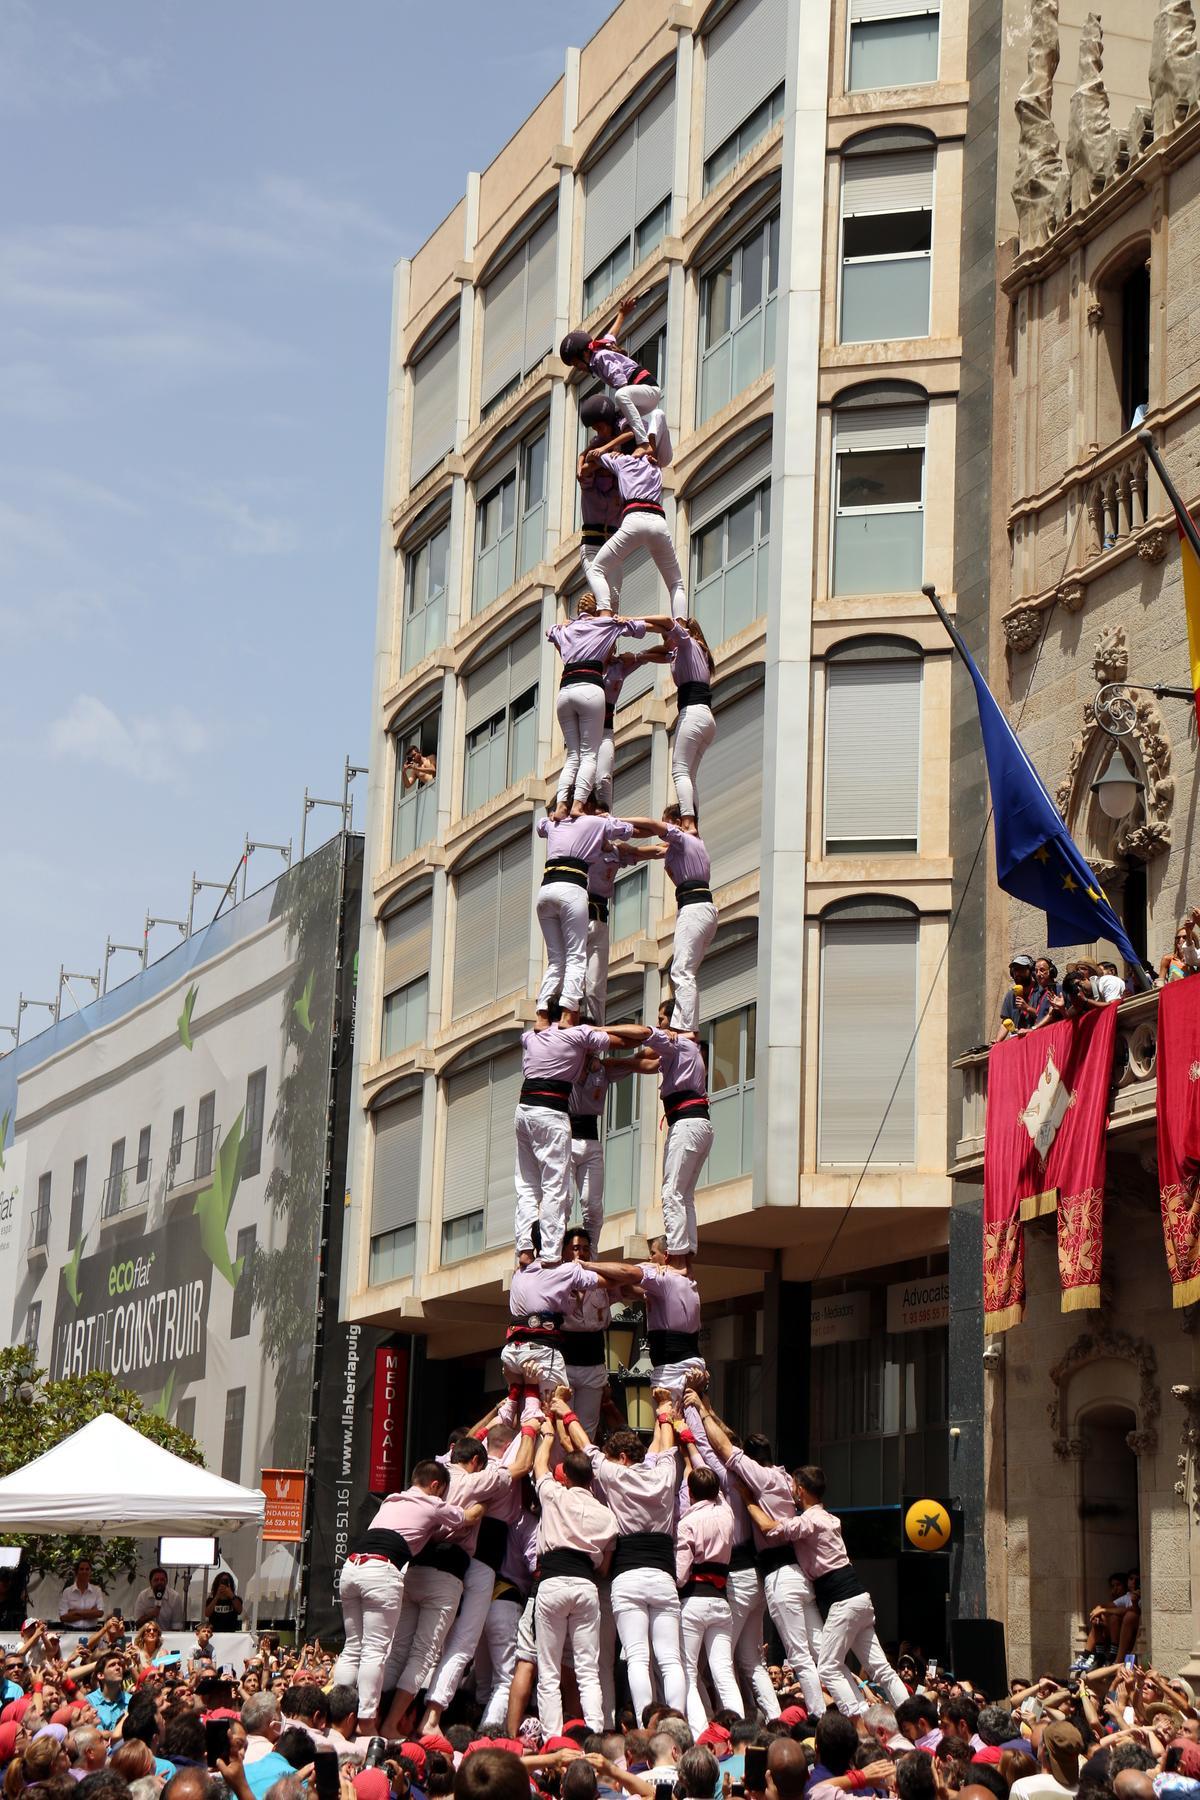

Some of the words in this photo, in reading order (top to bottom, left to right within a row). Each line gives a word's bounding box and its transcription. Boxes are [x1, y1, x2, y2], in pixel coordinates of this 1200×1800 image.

[902, 1283, 949, 1308] Advocats
[111, 1279, 204, 1377] CONSTRUIR
[382, 1355, 398, 1463] MEDICAL
[337, 1488, 350, 1508] 16
[265, 1510, 300, 1518] NDAMIOS
[287, 1519, 298, 1527] 194
[336, 1511, 349, 1528] 51
[335, 1532, 348, 1566] 788
